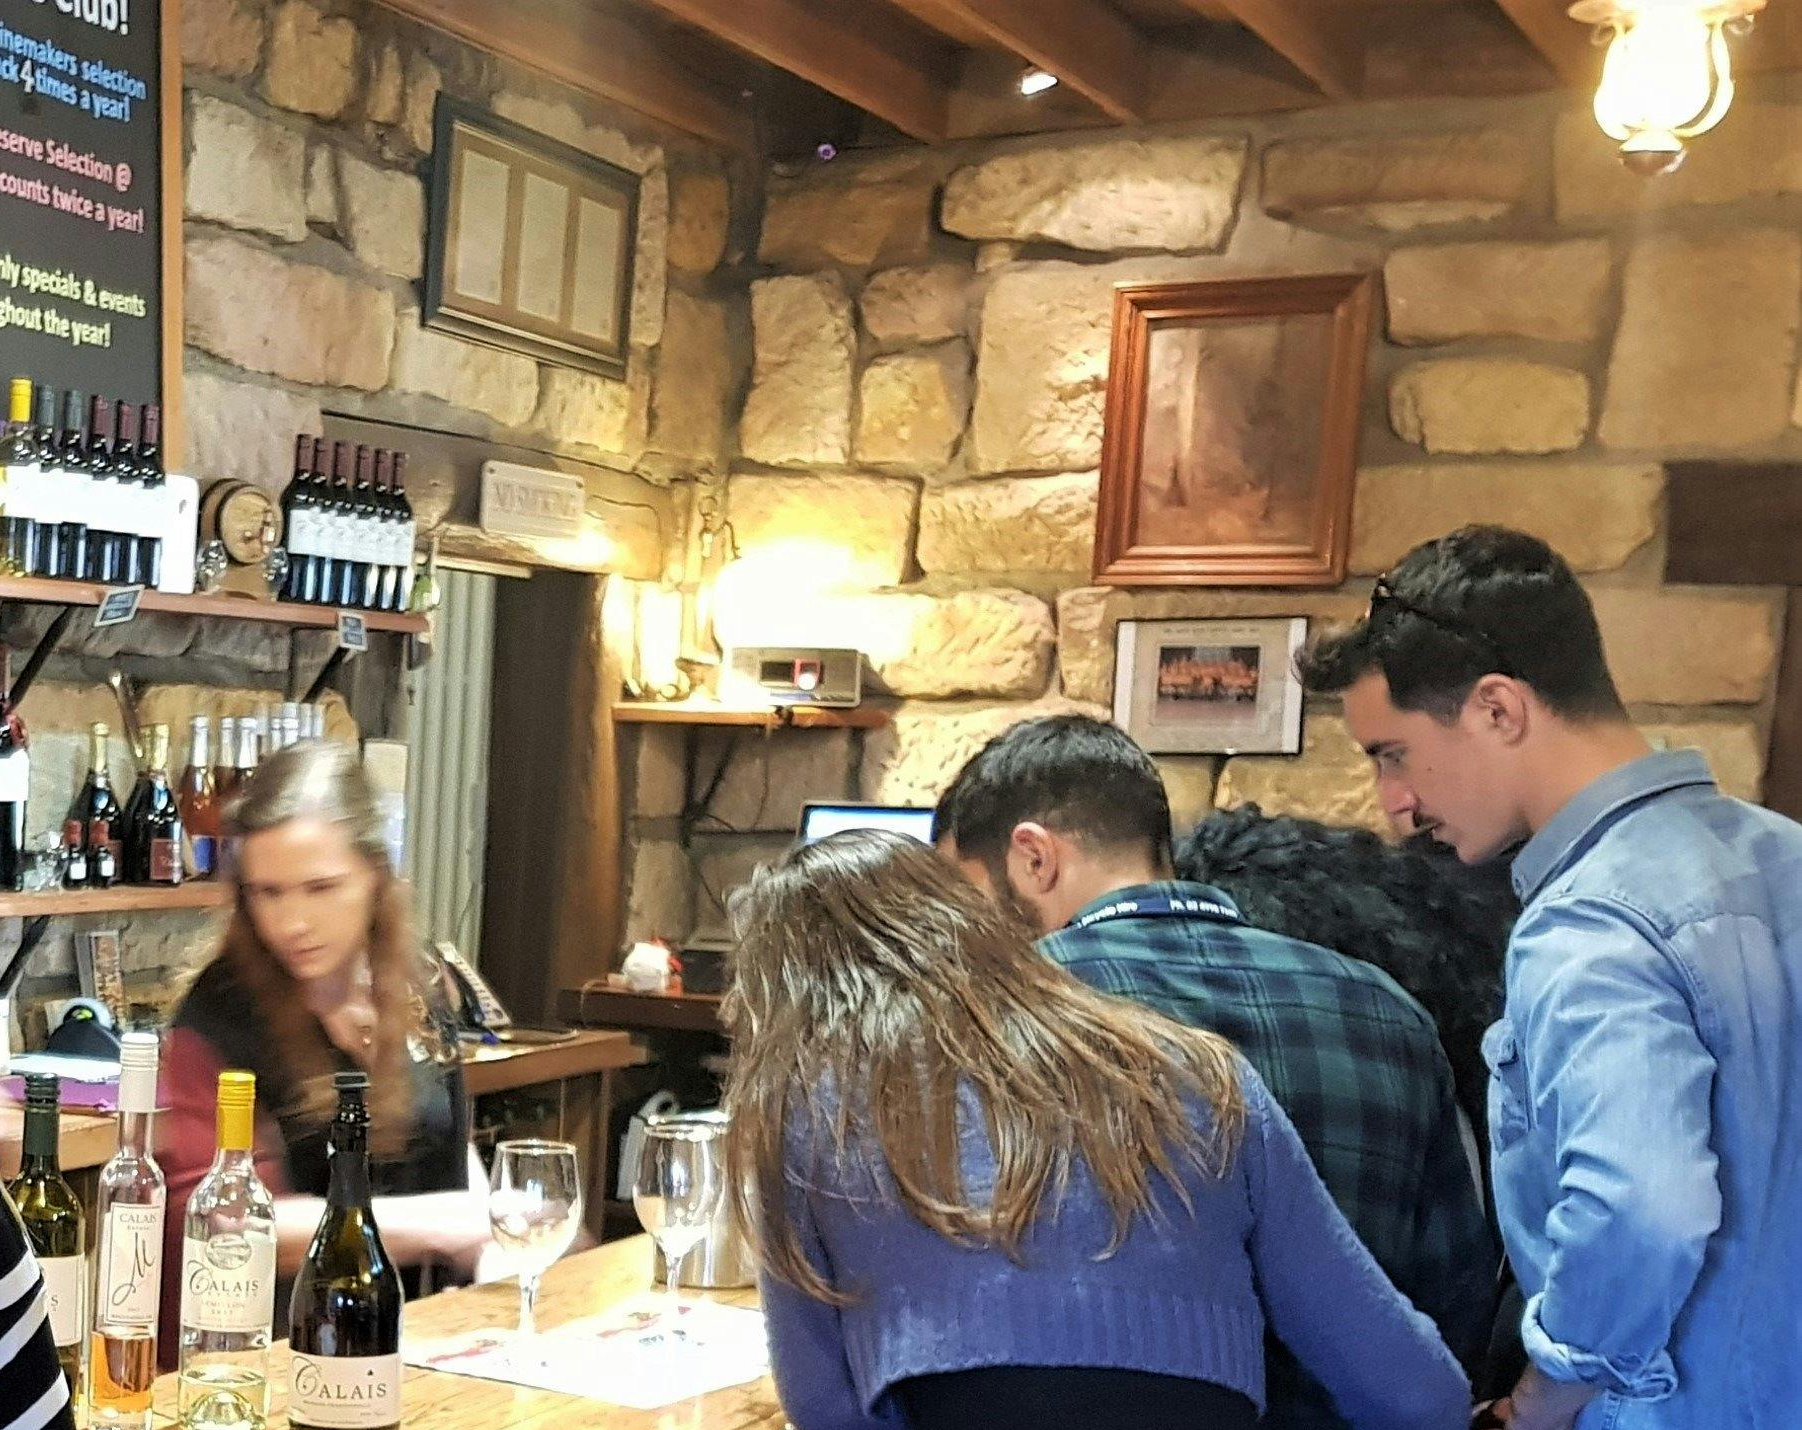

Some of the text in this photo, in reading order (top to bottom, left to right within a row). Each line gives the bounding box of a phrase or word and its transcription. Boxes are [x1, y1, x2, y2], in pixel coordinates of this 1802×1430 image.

[20, 59, 35, 93] 4
[35, 67, 78, 105] times
[79, 89, 91, 110] a
[81, 60, 147, 99] selection
[46, 140, 114, 185] Selection
[114, 163, 133, 193] @
[52, 186, 94, 219] twice
[94, 203, 106, 222] a
[107, 205, 145, 234] year!
[21, 268, 82, 301] specials
[82, 278, 98, 307] &
[99, 289, 147, 318] events
[43, 309, 71, 339] the
[71, 320, 112, 348] year!
[187, 1259, 259, 1296] CALAIS
[292, 1355, 388, 1397] CALAIS
